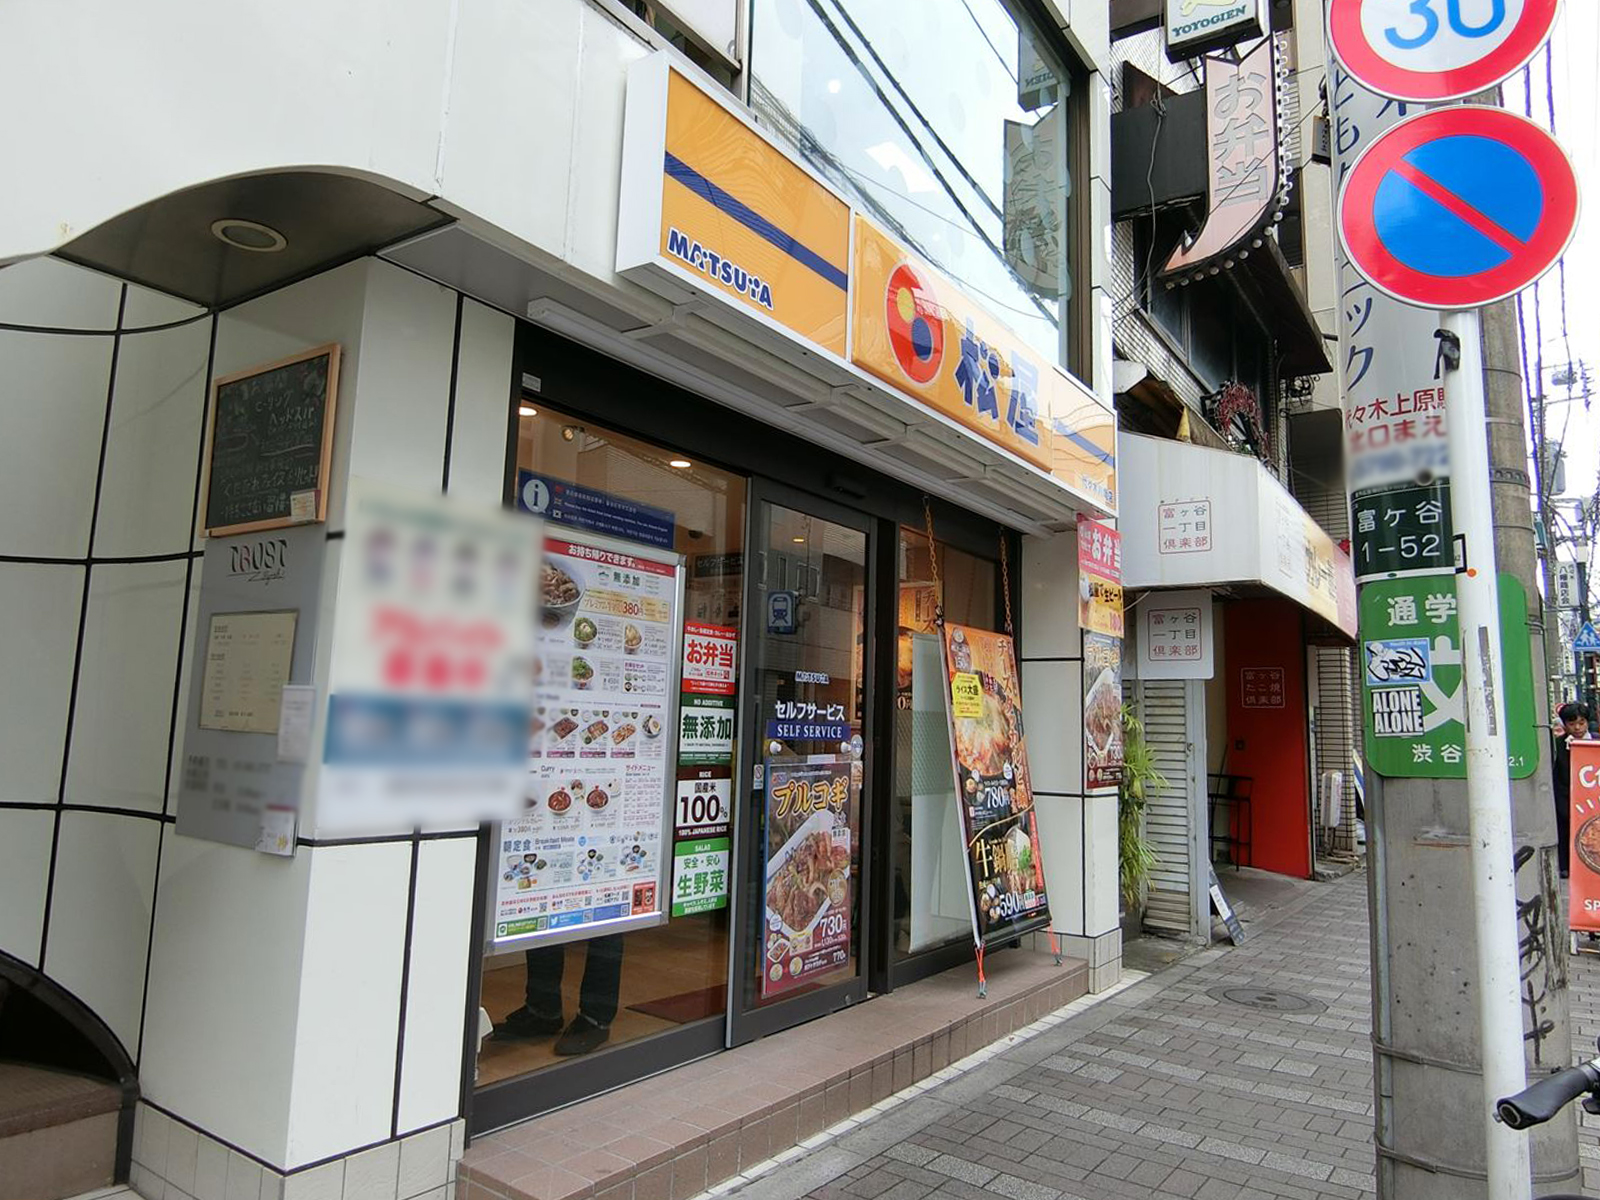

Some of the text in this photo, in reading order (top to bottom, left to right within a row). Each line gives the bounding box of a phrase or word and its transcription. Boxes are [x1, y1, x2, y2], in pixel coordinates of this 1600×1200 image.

[1172, 6, 1247, 37] YOYOGIEN
[1212, 71, 1270, 208] お弁当
[667, 226, 773, 310] MATSUYA
[954, 316, 1039, 446] 松屋
[1163, 521, 1206, 533] 一丁目
[1163, 536, 1208, 550] 倶楽部
[230, 539, 288, 573] TRUST
[622, 601, 639, 615] 380
[1387, 594, 1456, 626] 通学
[1152, 629, 1196, 640] 一丁目
[686, 639, 733, 669] お弁当
[1152, 645, 1198, 656] 倶楽部
[775, 700, 845, 721] セルフサービス
[1373, 689, 1422, 713] ALONE
[682, 713, 732, 740] 無添加
[777, 724, 842, 738] SELF SERVICE
[1375, 713, 1424, 737] ALONE
[1412, 744, 1462, 763] 渋谷
[694, 782, 716, 794] 国産米
[772, 777, 849, 816] プルコギ
[985, 786, 1005, 809] 780
[680, 795, 728, 824] 100%
[684, 854, 721, 868] 安全・安心
[677, 869, 724, 899] 生野菜
[1000, 890, 1020, 917] 590
[820, 914, 843, 937] 730
